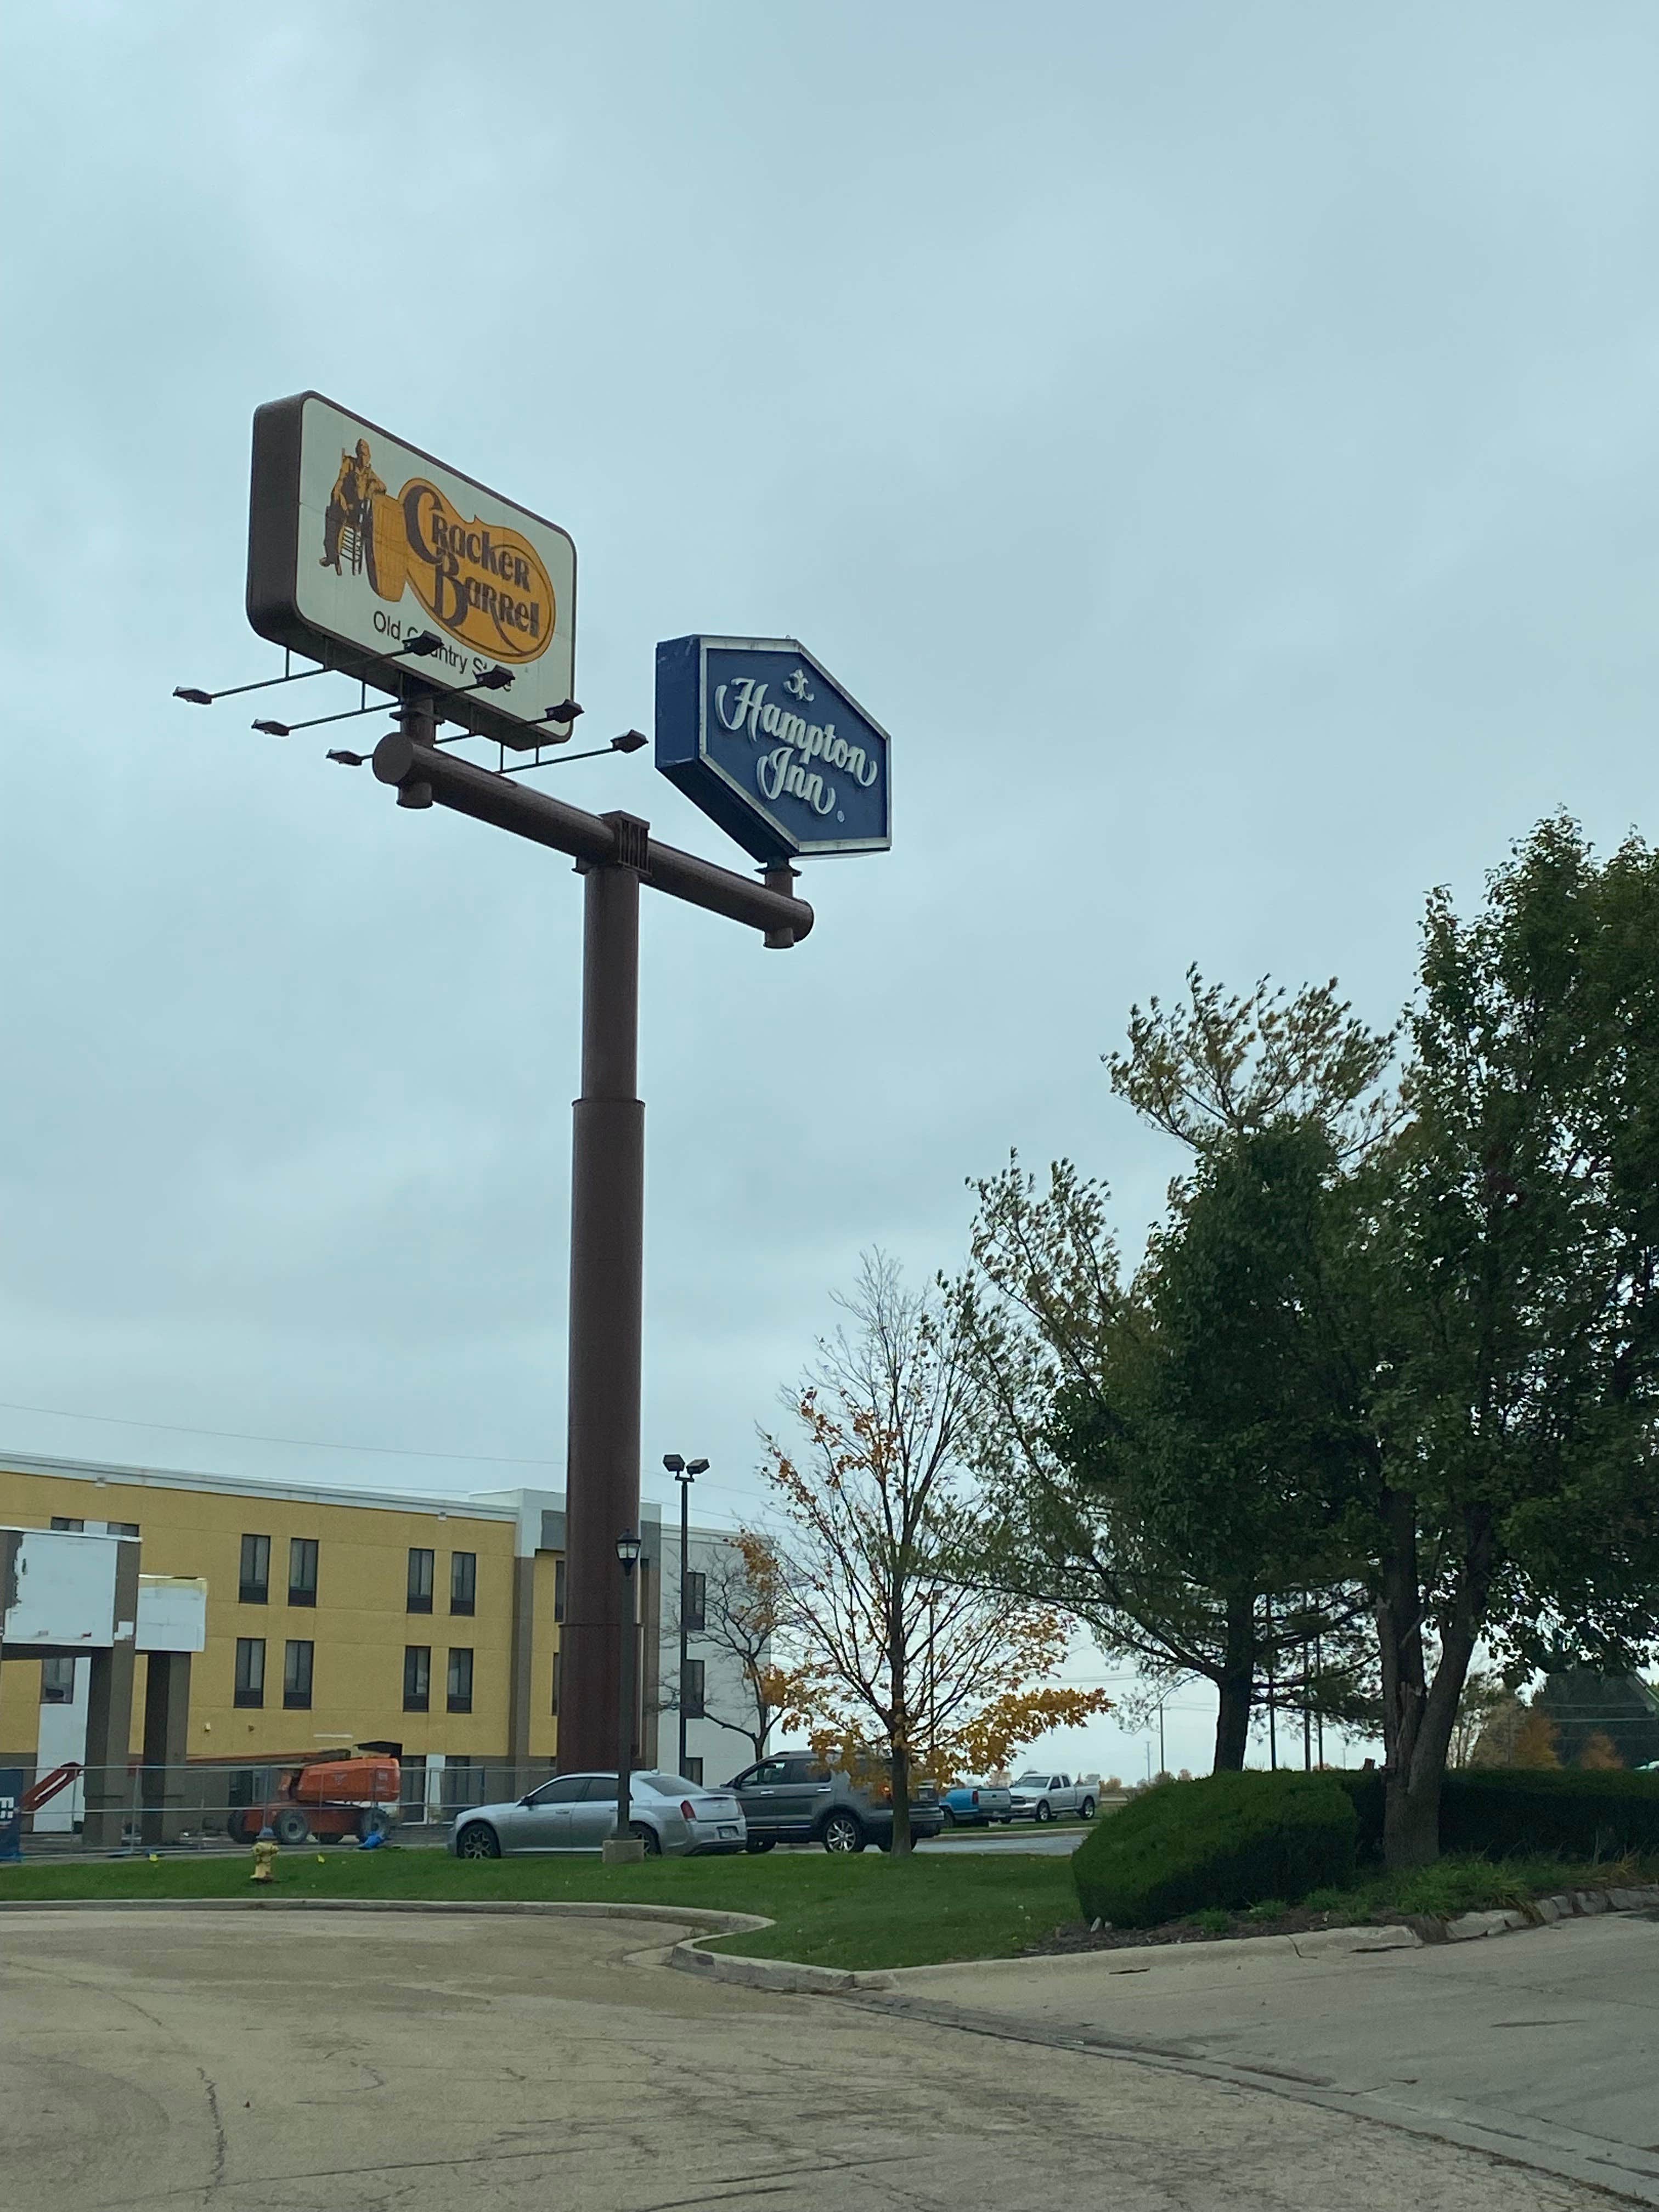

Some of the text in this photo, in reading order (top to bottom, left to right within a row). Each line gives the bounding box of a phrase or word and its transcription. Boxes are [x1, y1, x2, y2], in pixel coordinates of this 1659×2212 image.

[403, 485, 531, 593] Cracker
[373, 611, 400, 641] Old
[433, 548, 539, 639] Barrel
[715, 678, 877, 787] Hampton
[756, 747, 836, 815] Inn
